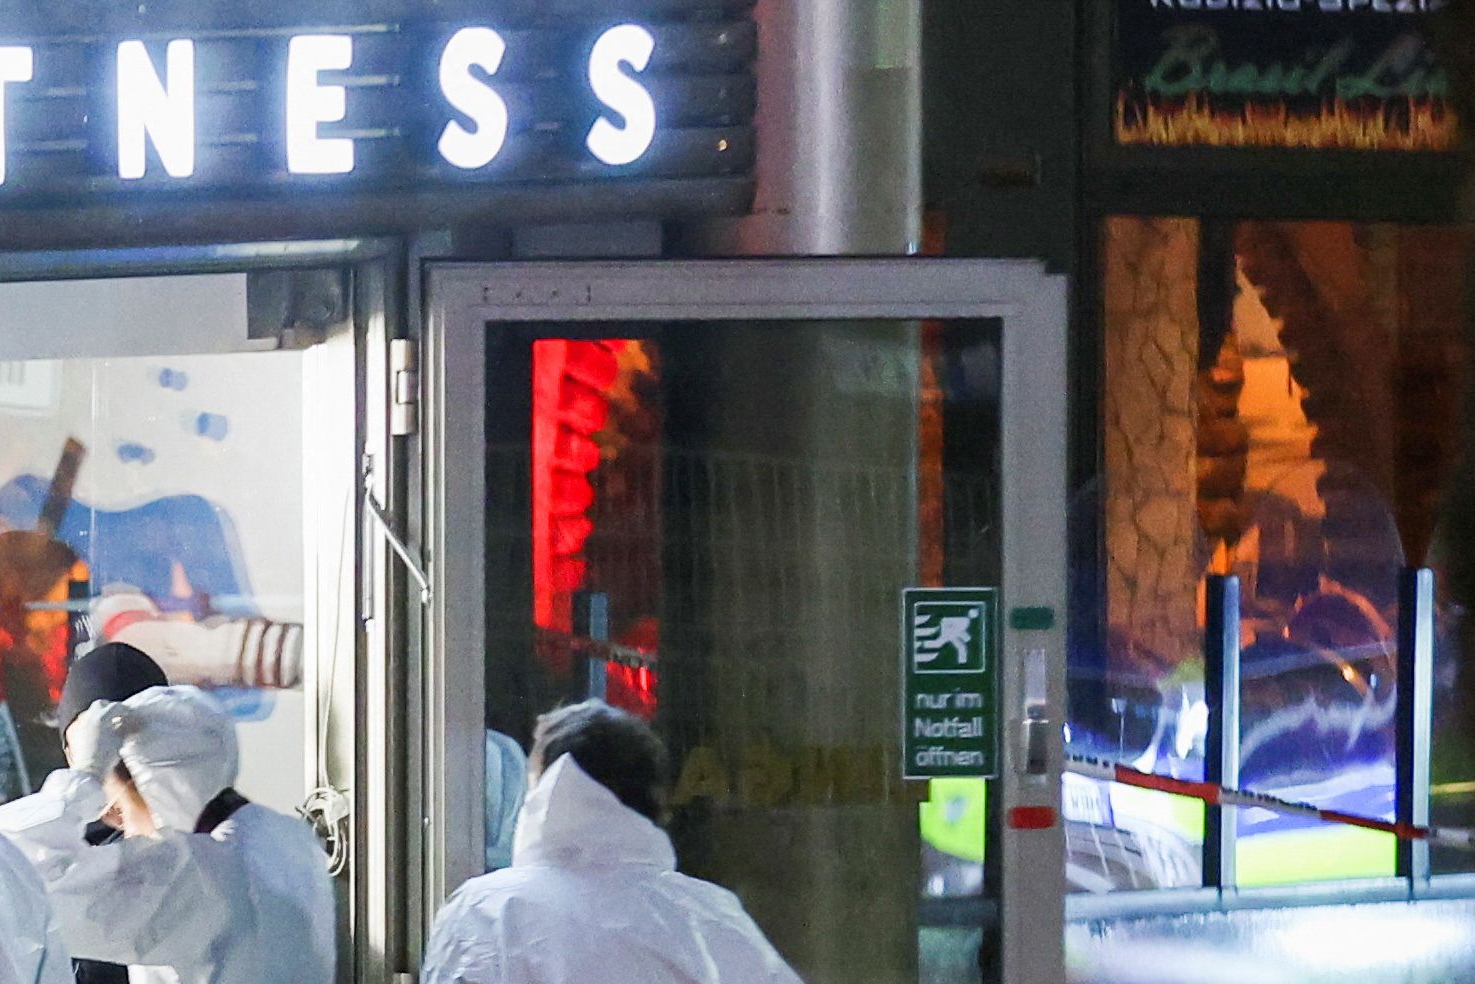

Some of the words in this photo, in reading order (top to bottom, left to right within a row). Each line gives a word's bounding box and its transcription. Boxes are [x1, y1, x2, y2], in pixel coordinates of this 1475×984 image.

[916, 692, 952, 709] nur
[954, 687, 983, 709] im
[915, 716, 984, 738] Notfall
[916, 745, 985, 767] öffnen
